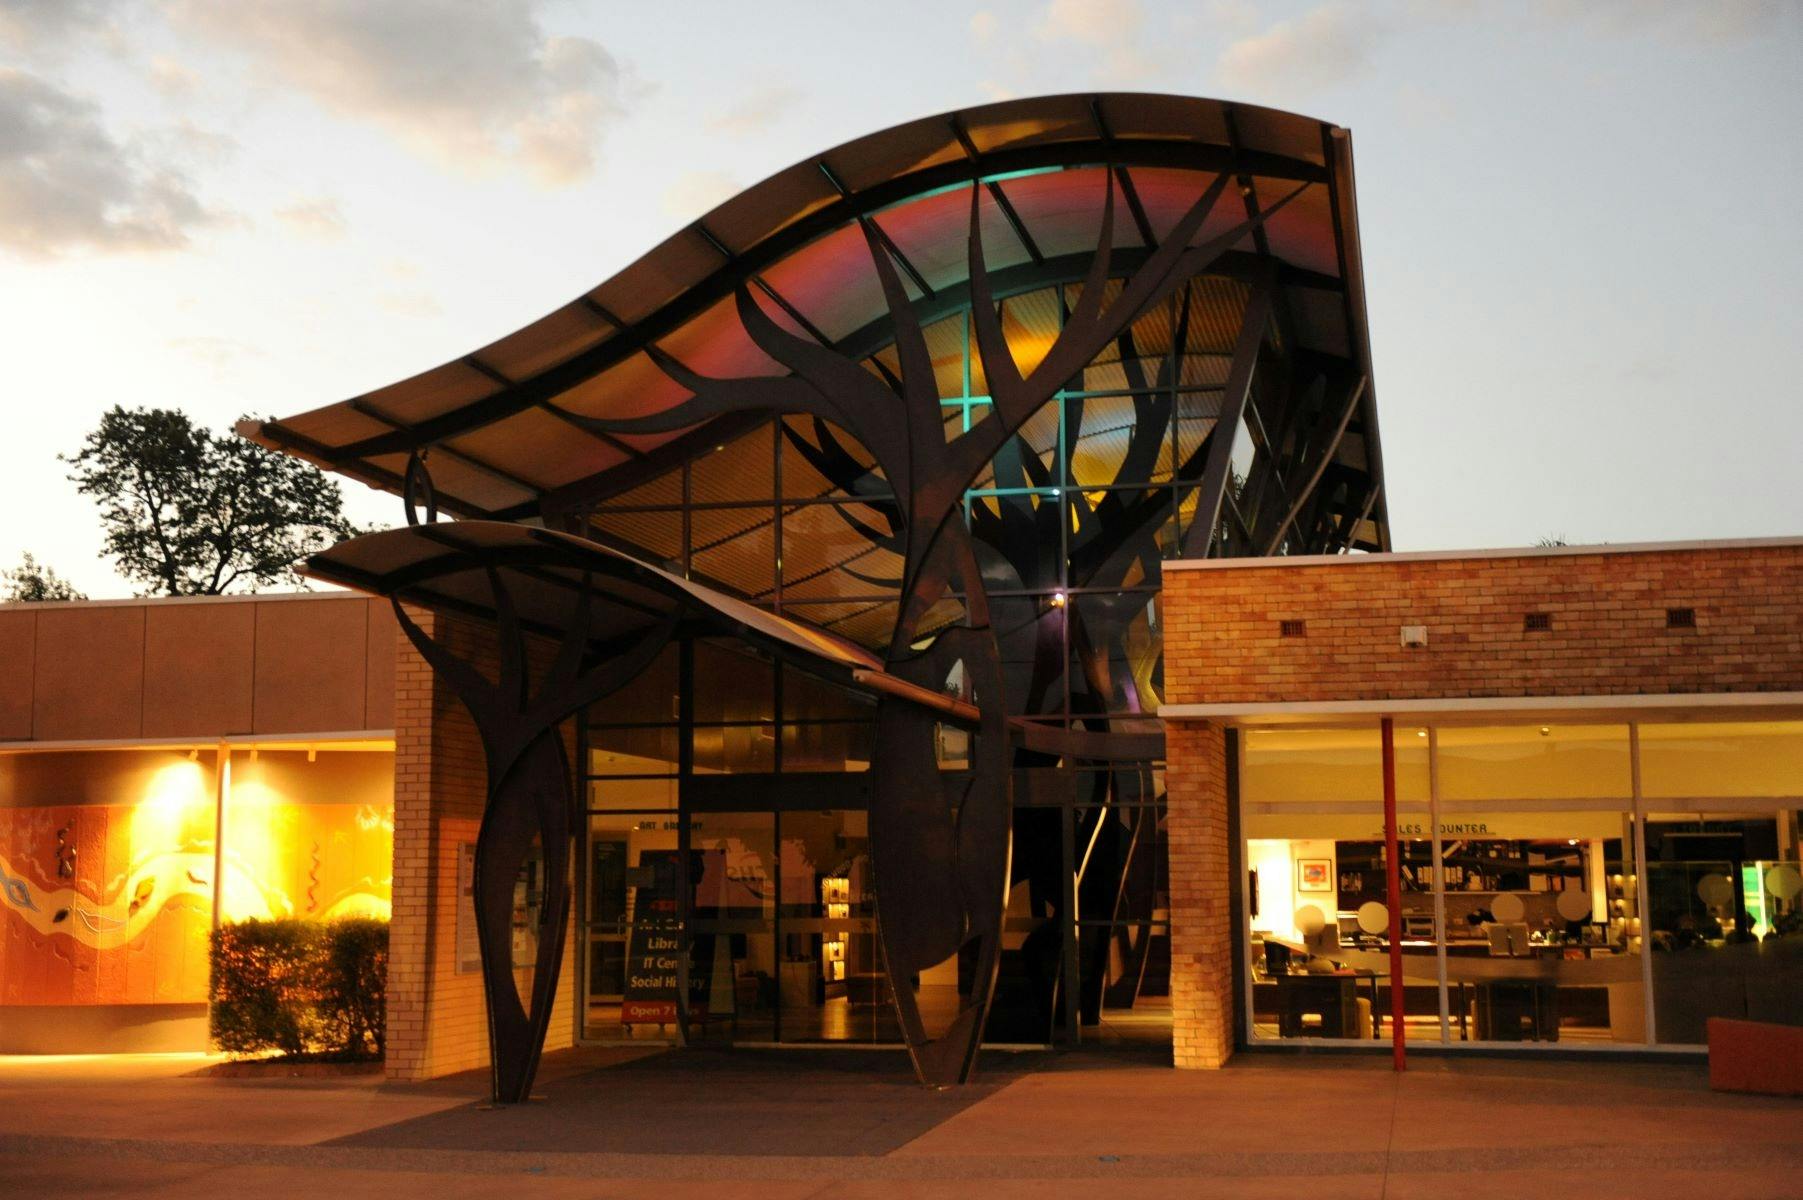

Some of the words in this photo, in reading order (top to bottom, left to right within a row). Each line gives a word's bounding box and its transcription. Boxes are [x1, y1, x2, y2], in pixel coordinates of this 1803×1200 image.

[643, 956, 655, 969] IT
[630, 975, 662, 988] Social
[630, 1005, 660, 1018] Open
[663, 1005, 672, 1016] 7
